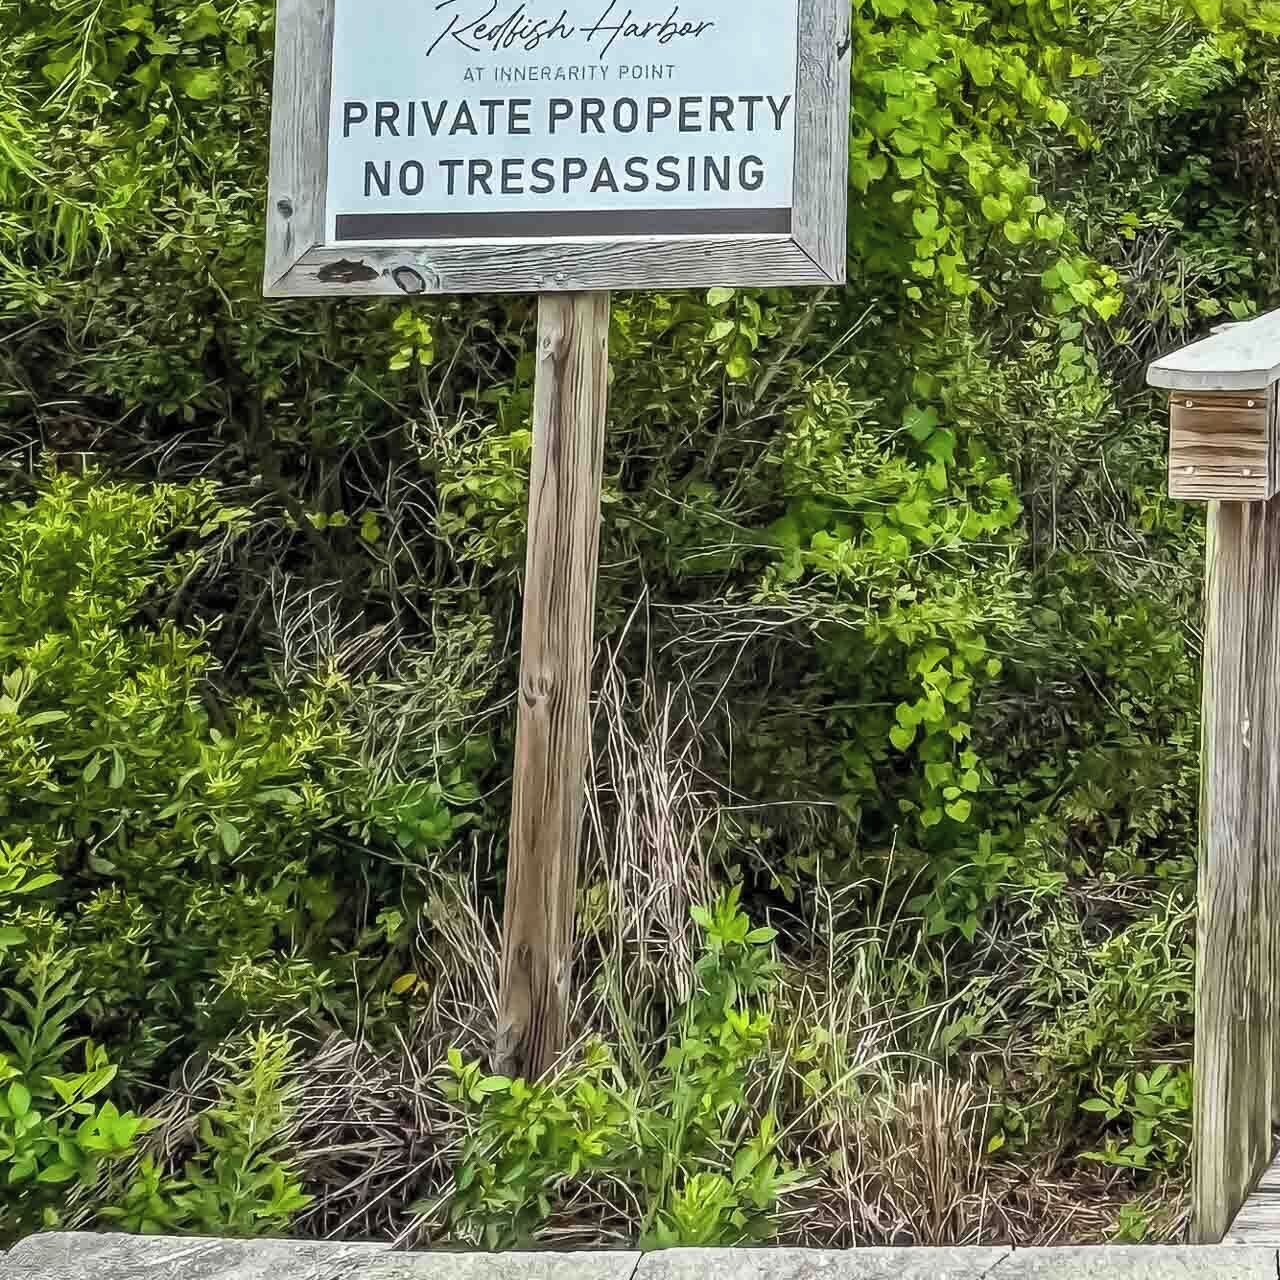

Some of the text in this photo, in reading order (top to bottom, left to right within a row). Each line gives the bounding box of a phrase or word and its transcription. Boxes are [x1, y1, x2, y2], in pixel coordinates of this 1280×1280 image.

[463, 64, 675, 81] AT INNERARITY POINT
[342, 95, 791, 137] PRIVATE PROPERTY
[363, 155, 765, 197] NO TRESPASSING
